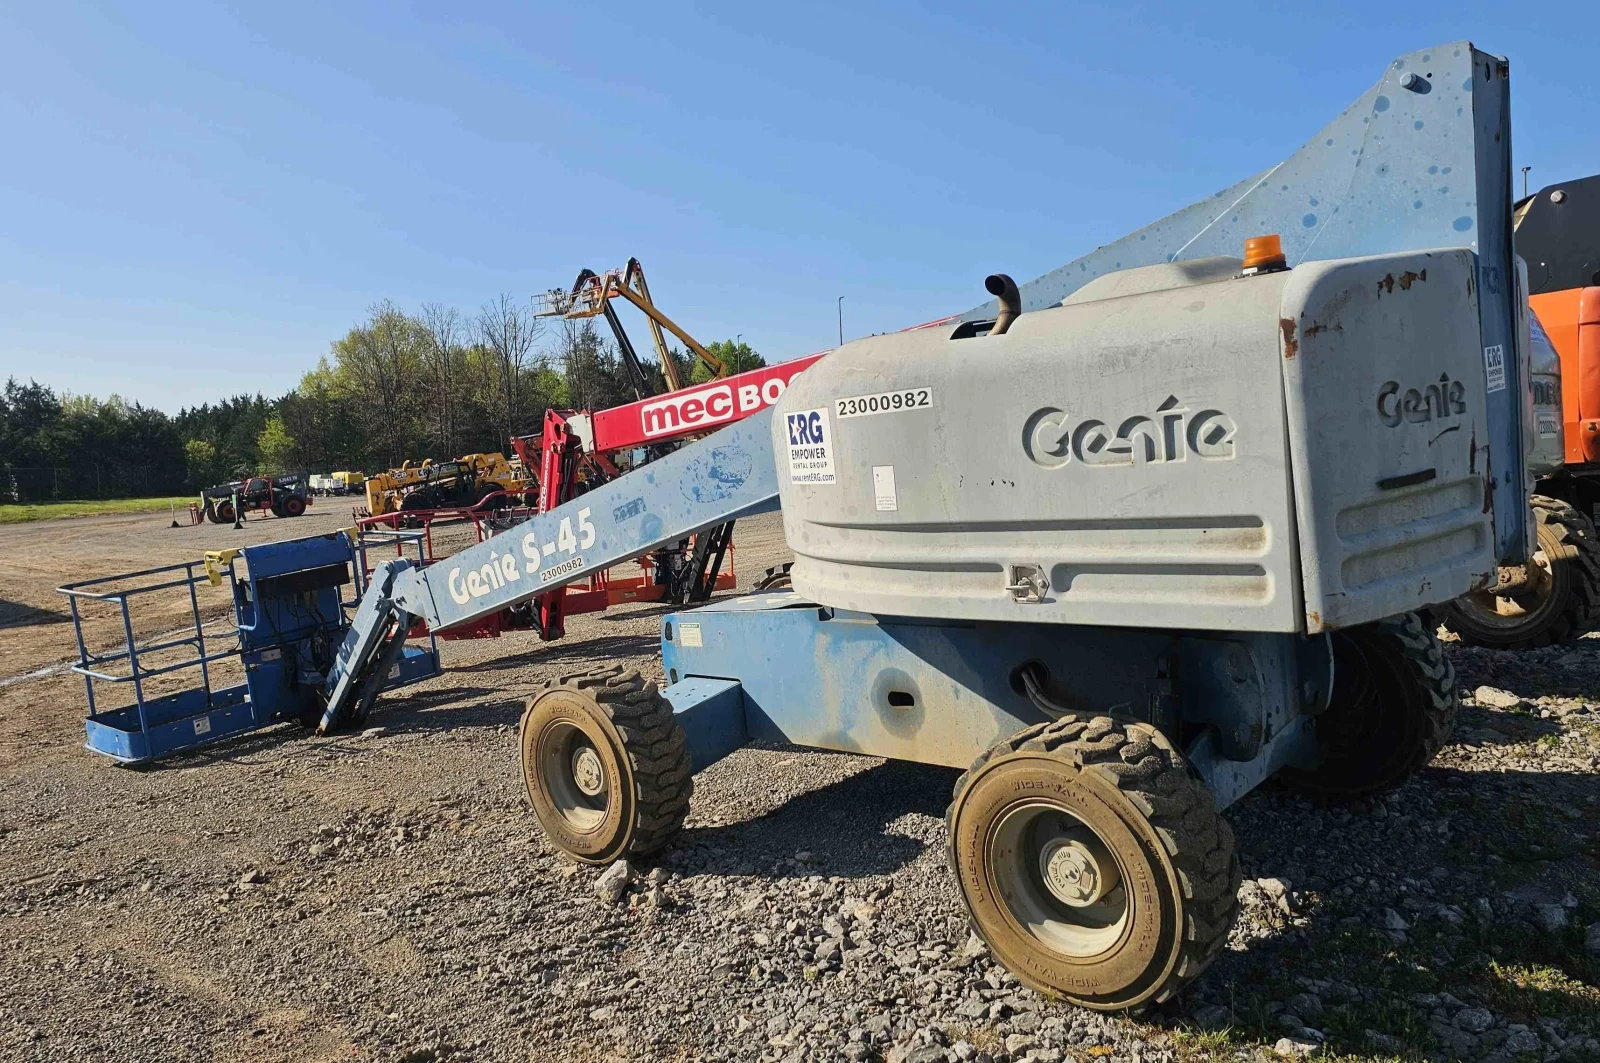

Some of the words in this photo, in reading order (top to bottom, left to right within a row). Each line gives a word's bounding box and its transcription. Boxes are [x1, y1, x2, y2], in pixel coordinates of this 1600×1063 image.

[643, 392, 732, 433] mec
[838, 390, 930, 416] 23000982
[1377, 371, 1466, 428] Genie
[787, 411, 824, 445] ERG
[1022, 394, 1238, 470] Genie
[791, 447, 827, 460] EMPOWER
[810, 461, 828, 469] GROUP
[448, 551, 521, 605] Genie
[522, 506, 596, 574] S-45
[541, 557, 583, 582] 23000982
